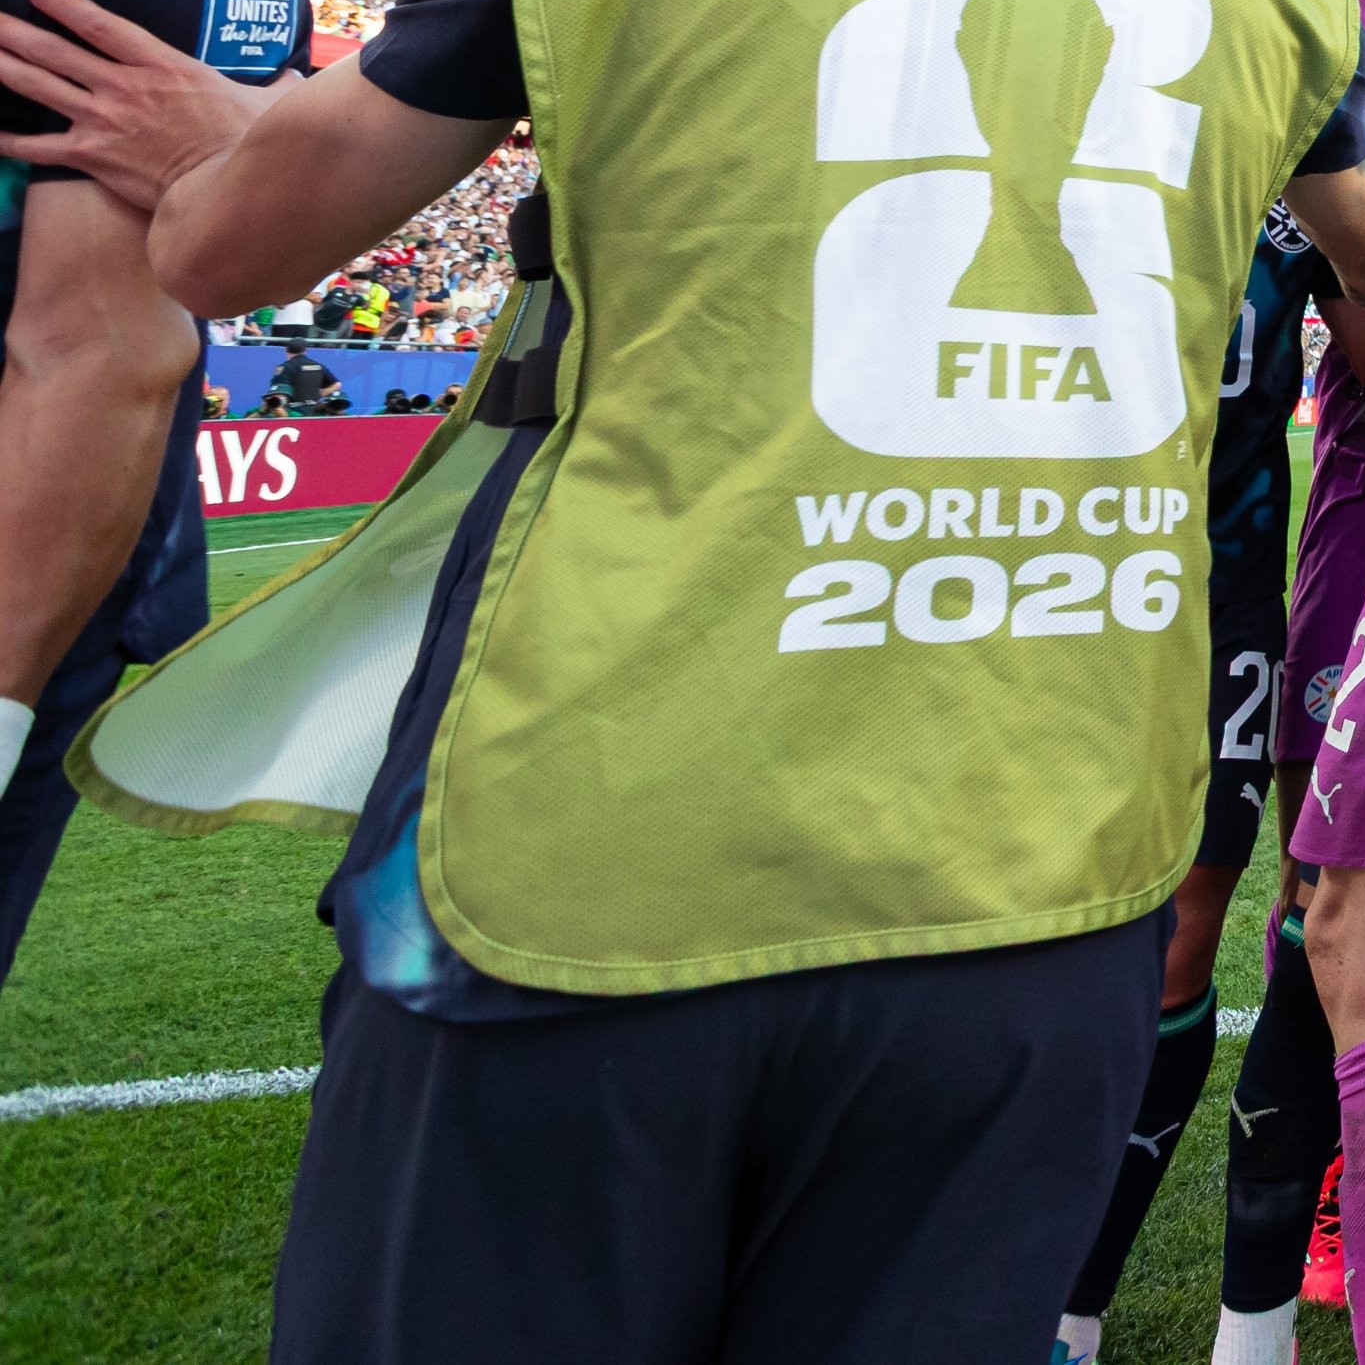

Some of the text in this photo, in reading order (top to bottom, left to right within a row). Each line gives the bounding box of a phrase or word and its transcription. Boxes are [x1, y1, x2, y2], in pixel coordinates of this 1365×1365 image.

[219, 22, 248, 42] the
[936, 341, 1112, 402] FIFA
[796, 486, 1189, 547] WORLD CUP
[777, 550, 1183, 654] 2026
